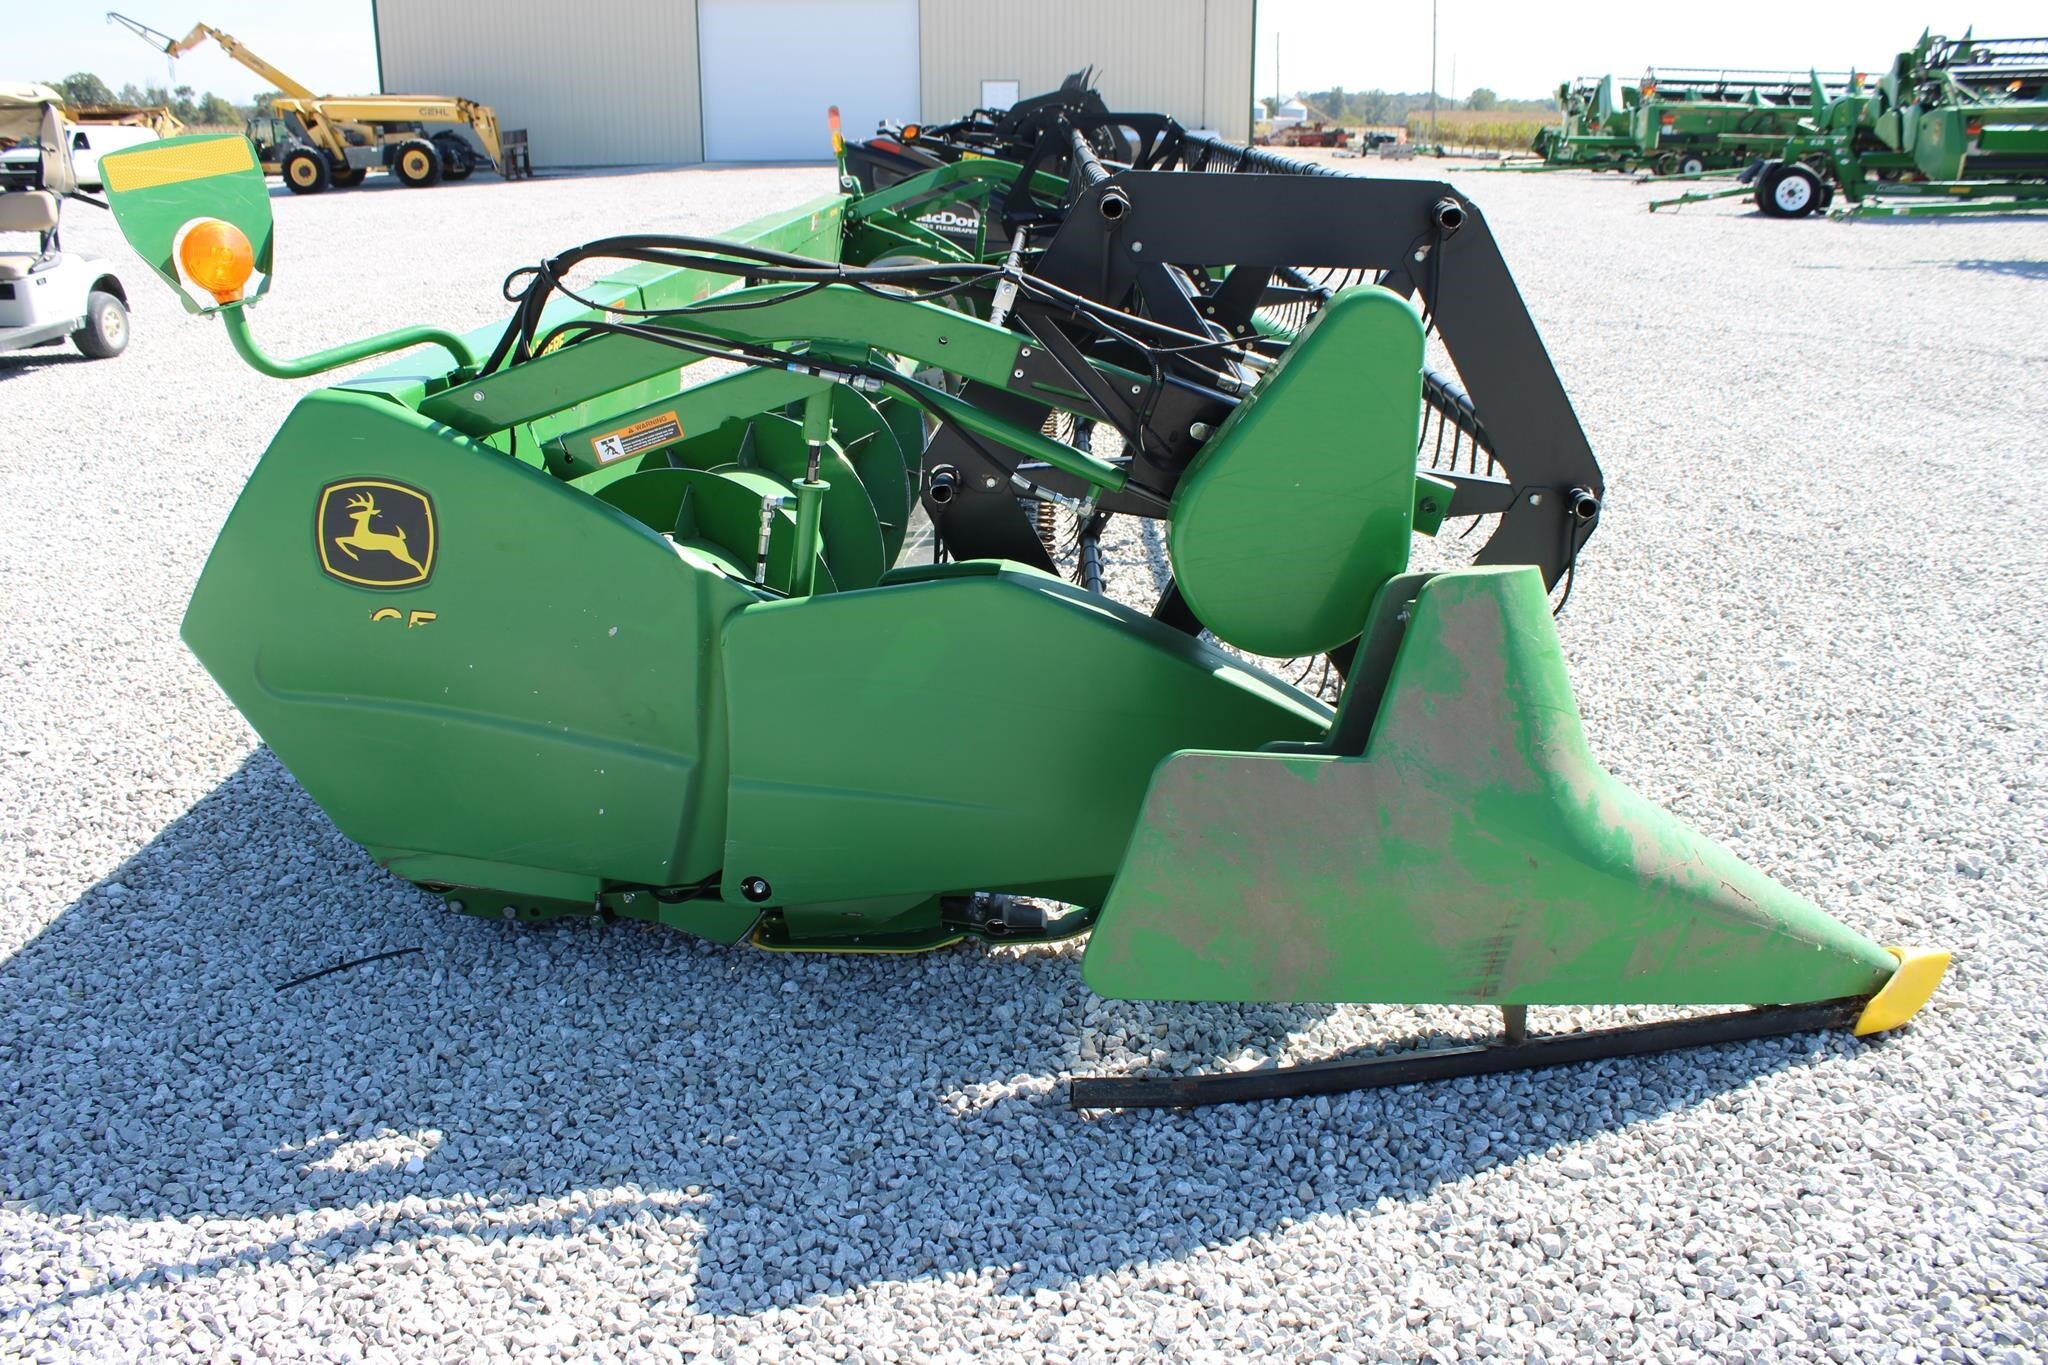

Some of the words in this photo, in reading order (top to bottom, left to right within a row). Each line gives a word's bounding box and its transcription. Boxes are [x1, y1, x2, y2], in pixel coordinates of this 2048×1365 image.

[419, 106, 449, 116] GEHL
[915, 211, 979, 228] acDon
[635, 416, 667, 430] WARNING
